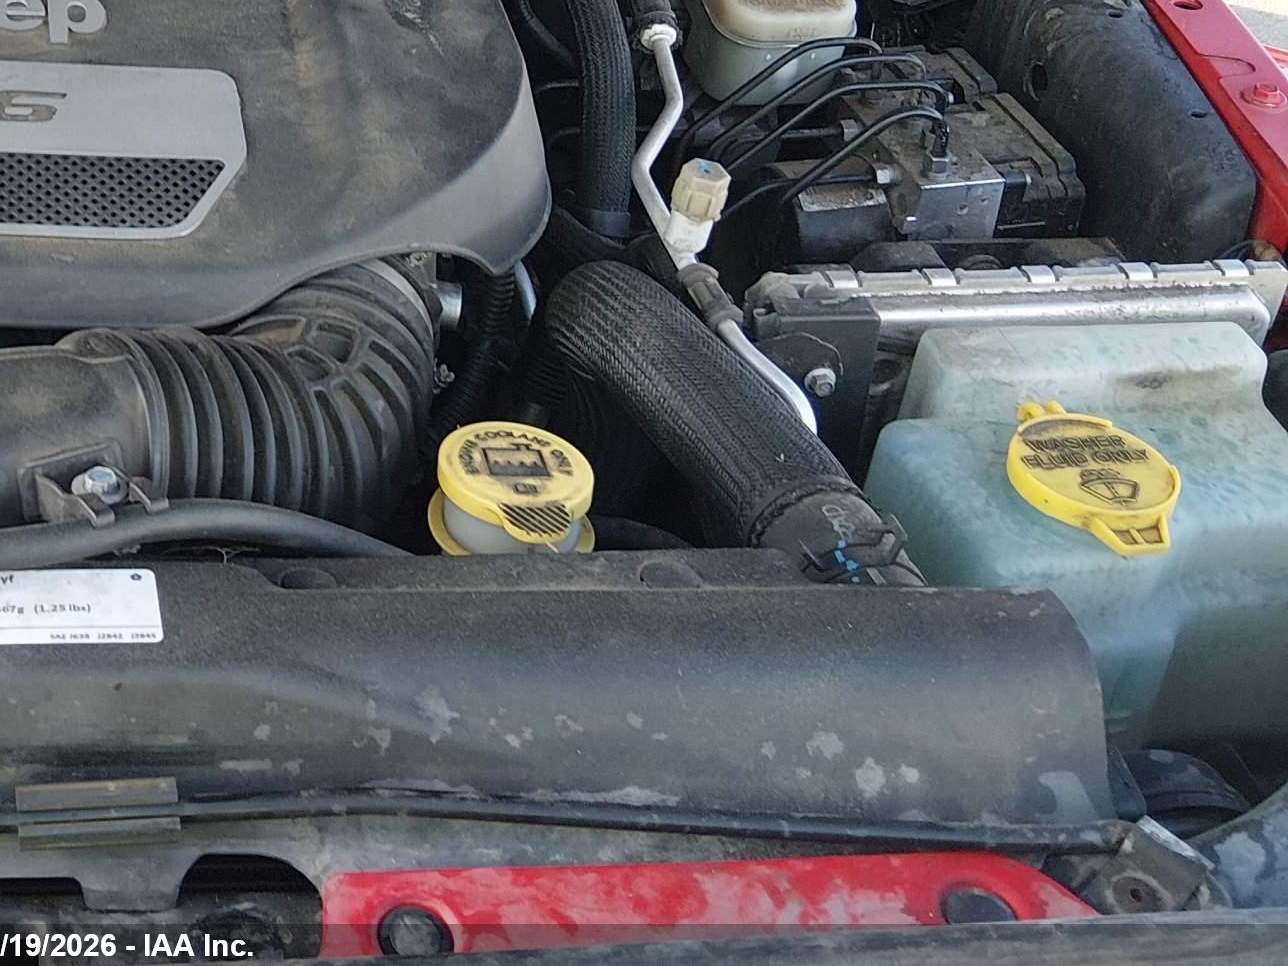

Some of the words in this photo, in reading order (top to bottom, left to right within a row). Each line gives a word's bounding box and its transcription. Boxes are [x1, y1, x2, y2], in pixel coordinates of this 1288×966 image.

[474, 430, 552, 447] COOLANT
[550, 449, 574, 476] ONLY
[1024, 435, 1128, 452] WASHER
[1020, 451, 1089, 470] FLUID
[1091, 449, 1150, 464] ONLY
[34, 604, 66, 614] (1.25
[68, 603, 92, 614] lbs)
